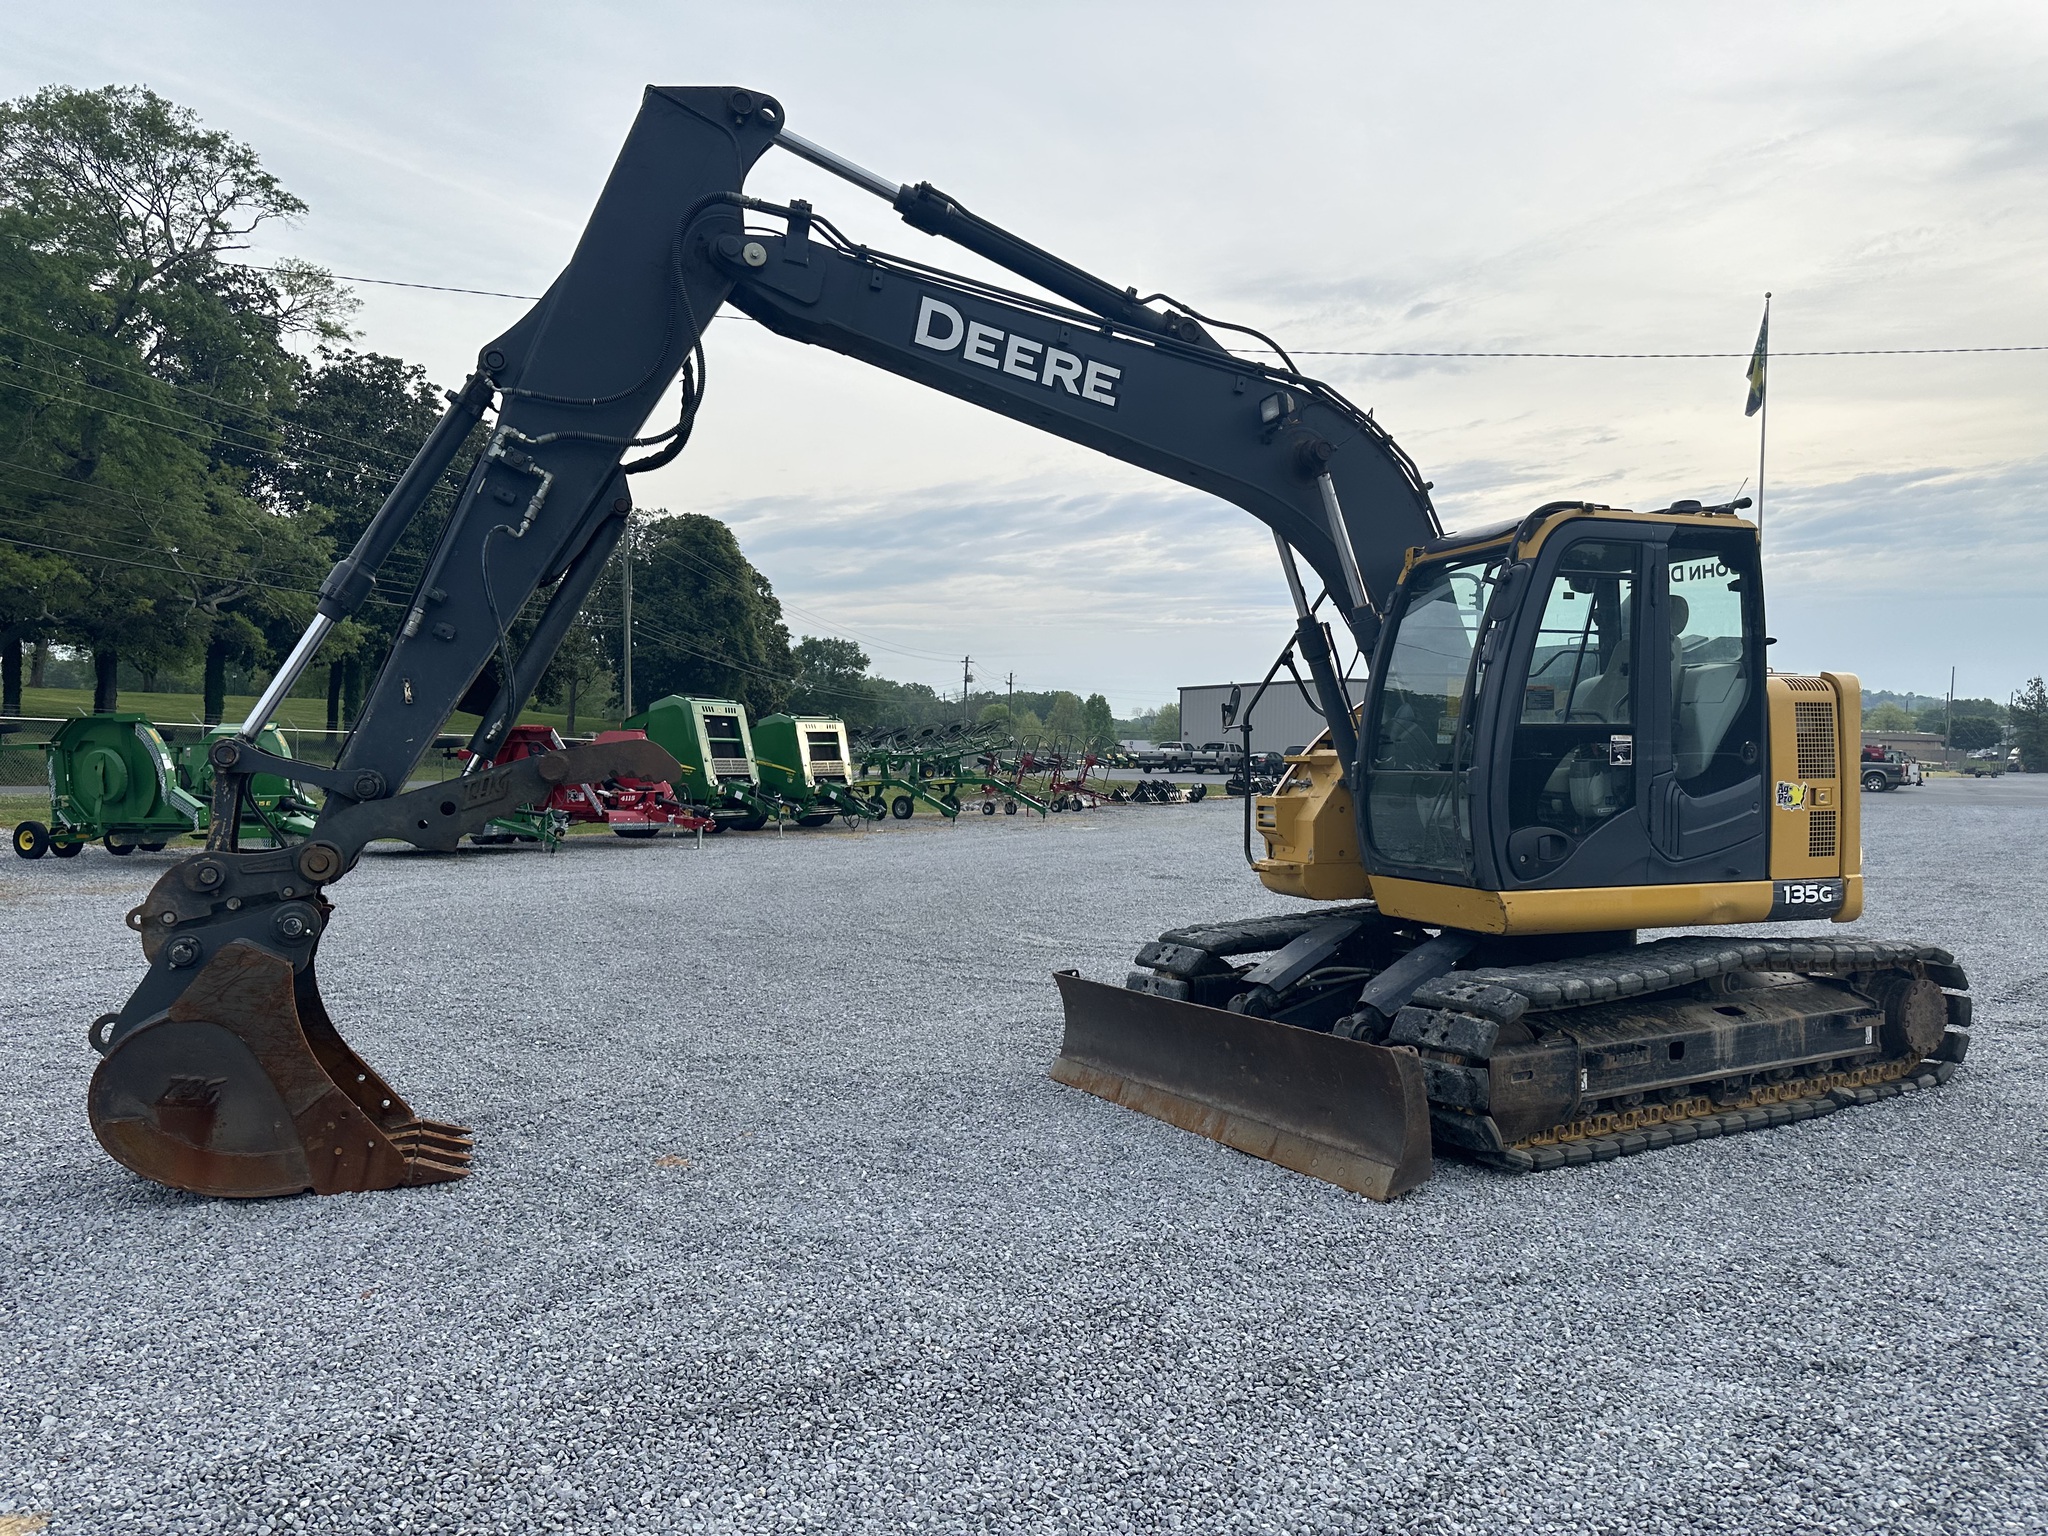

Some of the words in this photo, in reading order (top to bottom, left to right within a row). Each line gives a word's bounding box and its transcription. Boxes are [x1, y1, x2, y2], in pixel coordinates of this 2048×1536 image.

[914, 296, 1121, 407] DEERE
[1777, 794, 1793, 803] Pro
[1783, 885, 1833, 904] 135G
